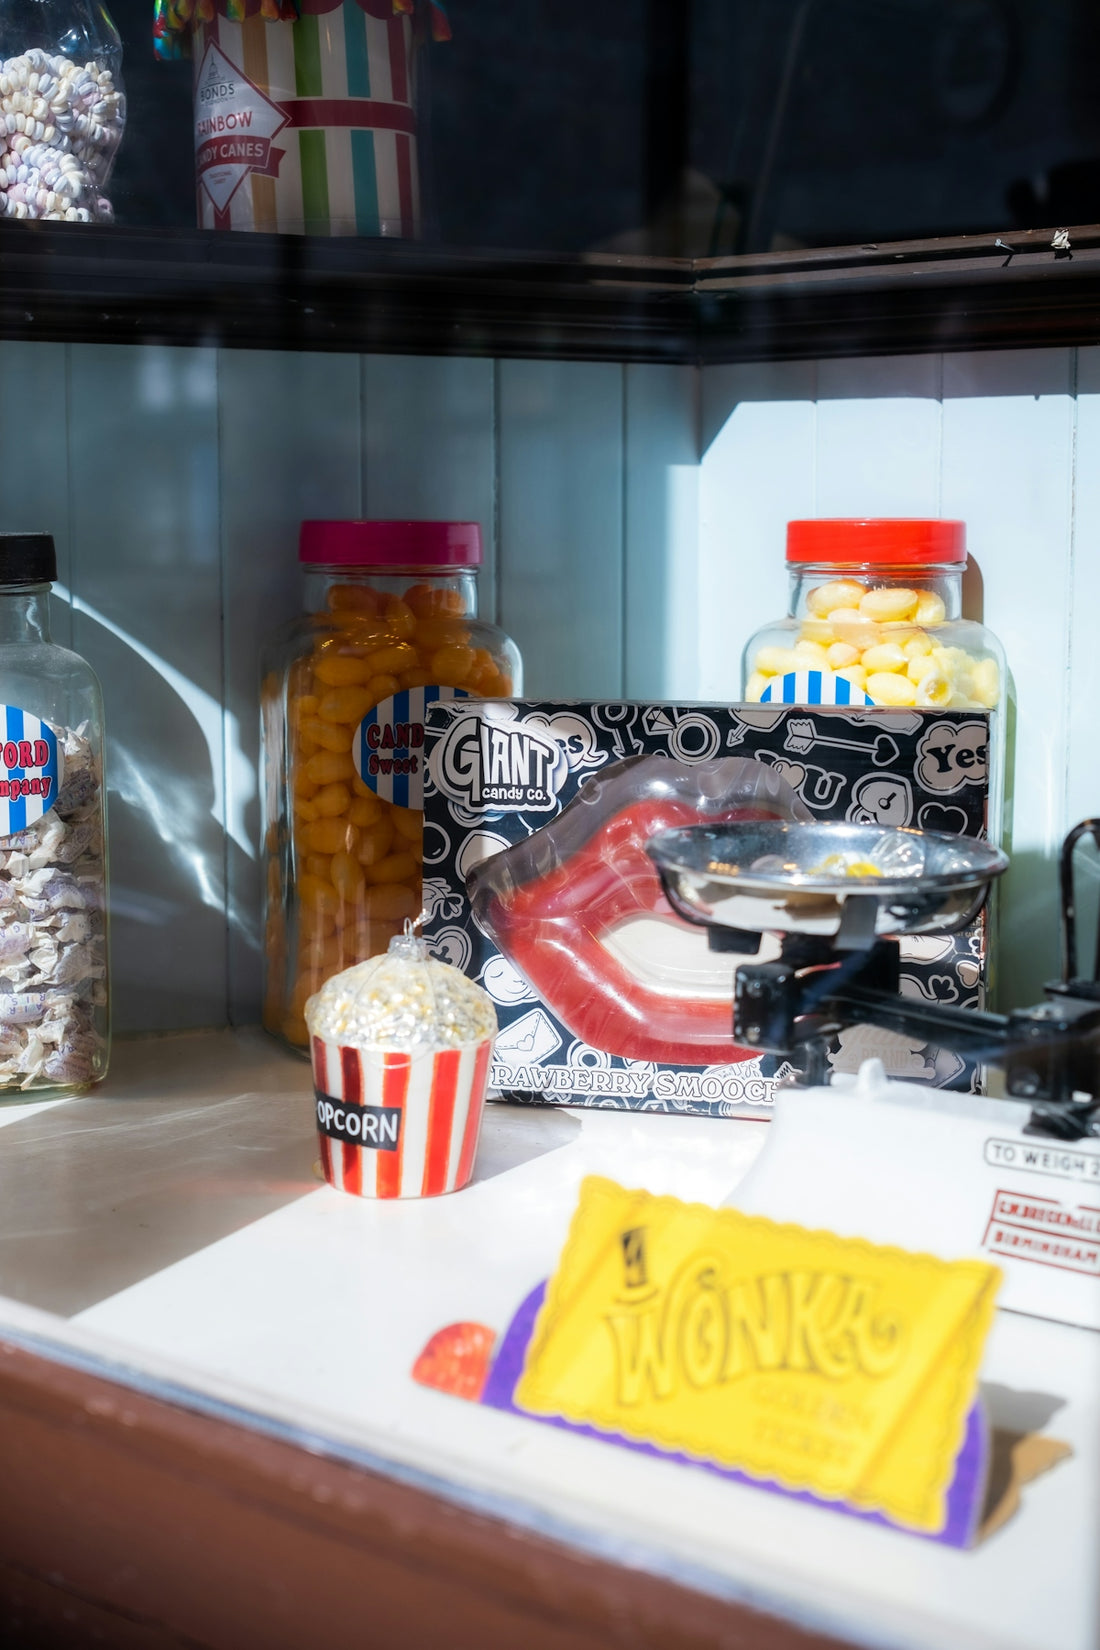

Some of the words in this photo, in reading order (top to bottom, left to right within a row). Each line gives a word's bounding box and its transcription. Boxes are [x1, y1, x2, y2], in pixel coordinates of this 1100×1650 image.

[220, 142, 265, 158] CANES
[559, 733, 584, 754] es
[369, 754, 418, 776] Sweet
[444, 717, 550, 801] GIANT
[482, 787, 523, 801] candy
[526, 789, 547, 801] co.
[491, 1064, 650, 1095] RAWBERRY
[993, 1144, 1015, 1162] TO
[1024, 1149, 1086, 1174] WEIGH
[602, 1252, 906, 1408] WONKA
